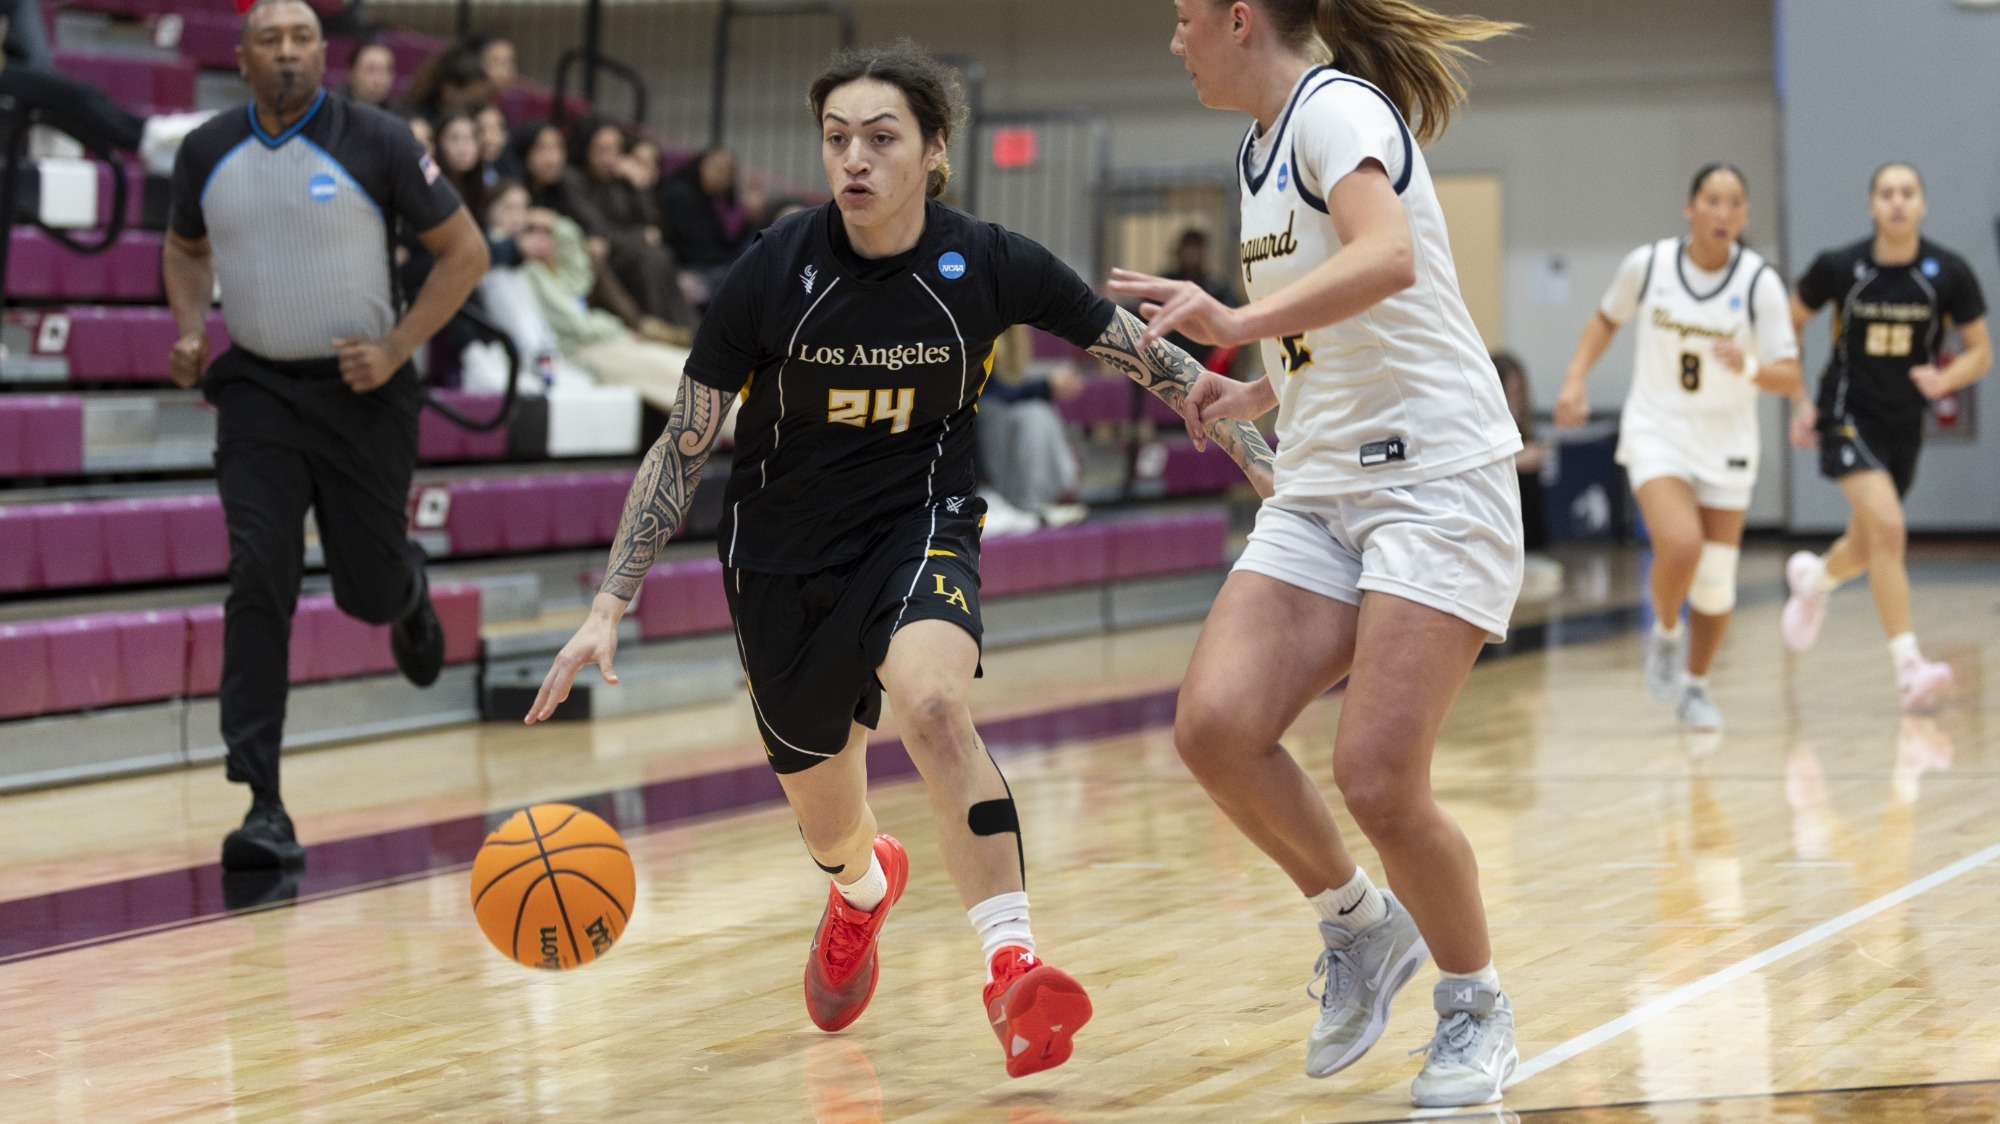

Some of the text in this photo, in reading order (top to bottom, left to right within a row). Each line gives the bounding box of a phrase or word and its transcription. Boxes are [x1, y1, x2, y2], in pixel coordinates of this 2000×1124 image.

[942, 264, 964, 272] NCAA
[798, 342, 950, 371] Los Angeles
[1680, 351, 1700, 392] 8
[827, 387, 916, 434] 24
[1388, 443, 1399, 455] M
[932, 573, 971, 615] LA
